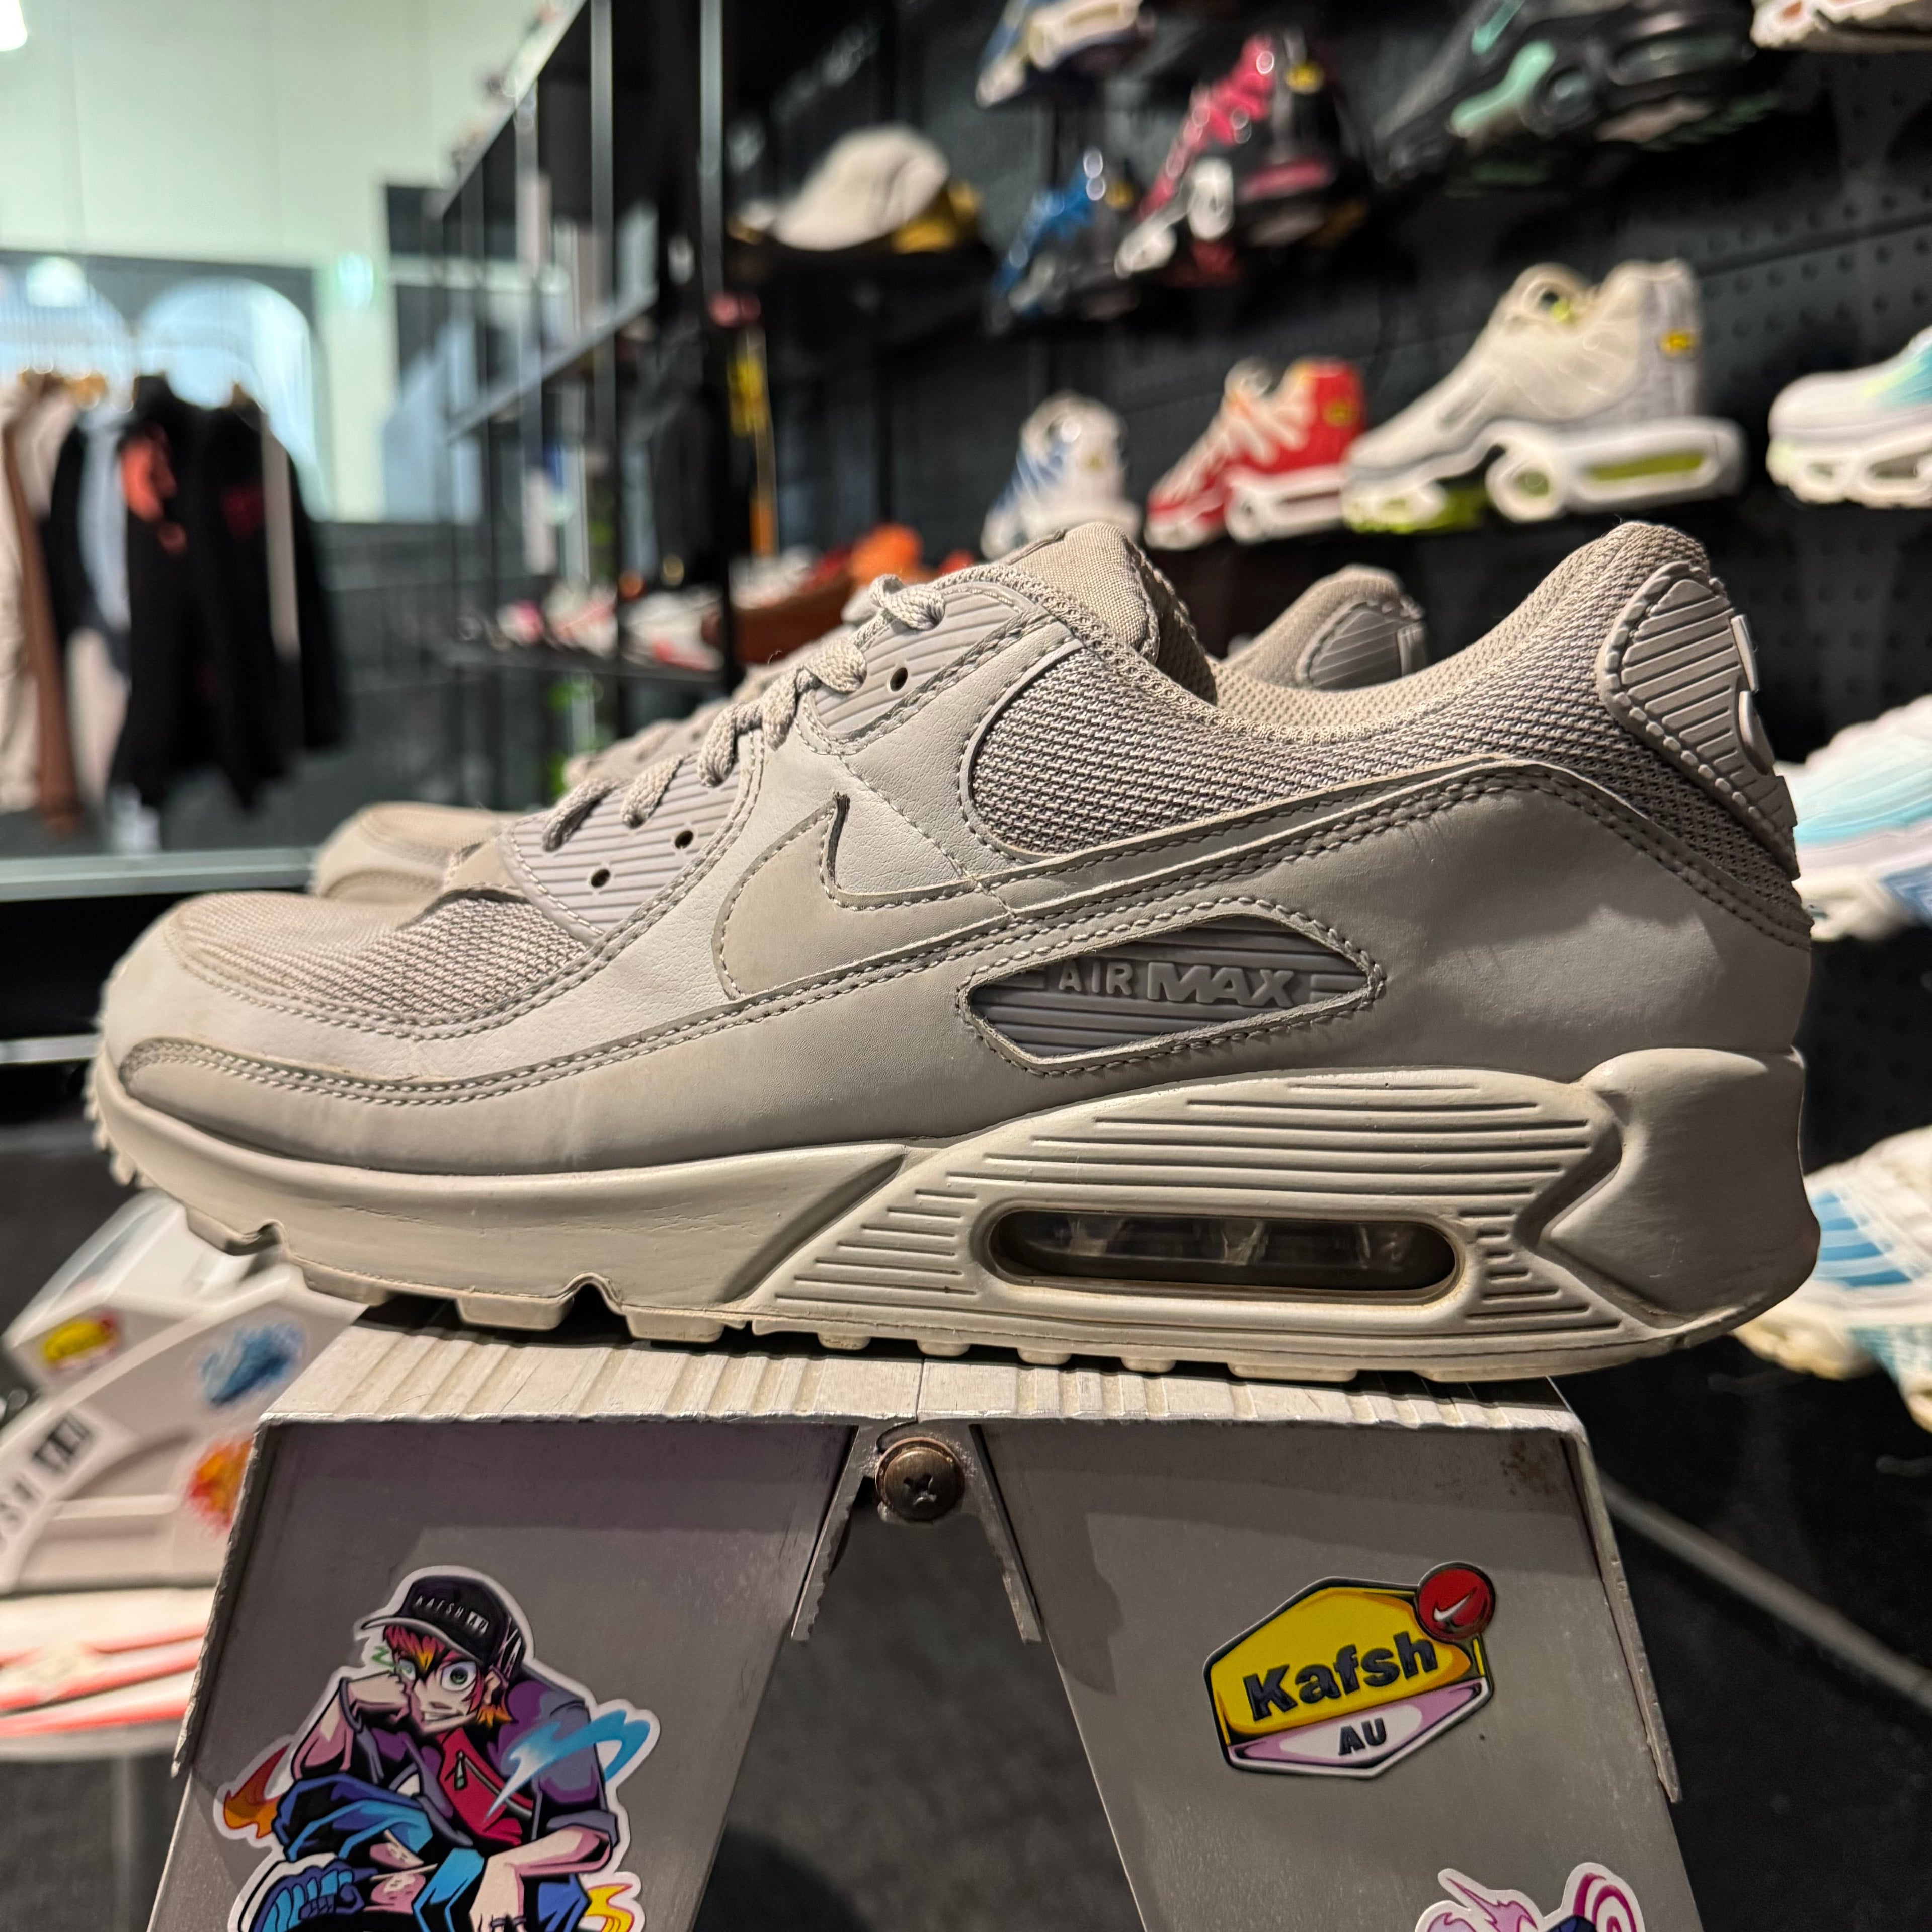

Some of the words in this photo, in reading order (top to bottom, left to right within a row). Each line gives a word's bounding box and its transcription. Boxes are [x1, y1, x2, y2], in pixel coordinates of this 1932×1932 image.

[1058, 959, 1132, 995] AIR
[1147, 962, 1294, 1007] MAX
[1243, 1631, 1438, 1722] Kafsh
[1338, 1717, 1387, 1755] AU
